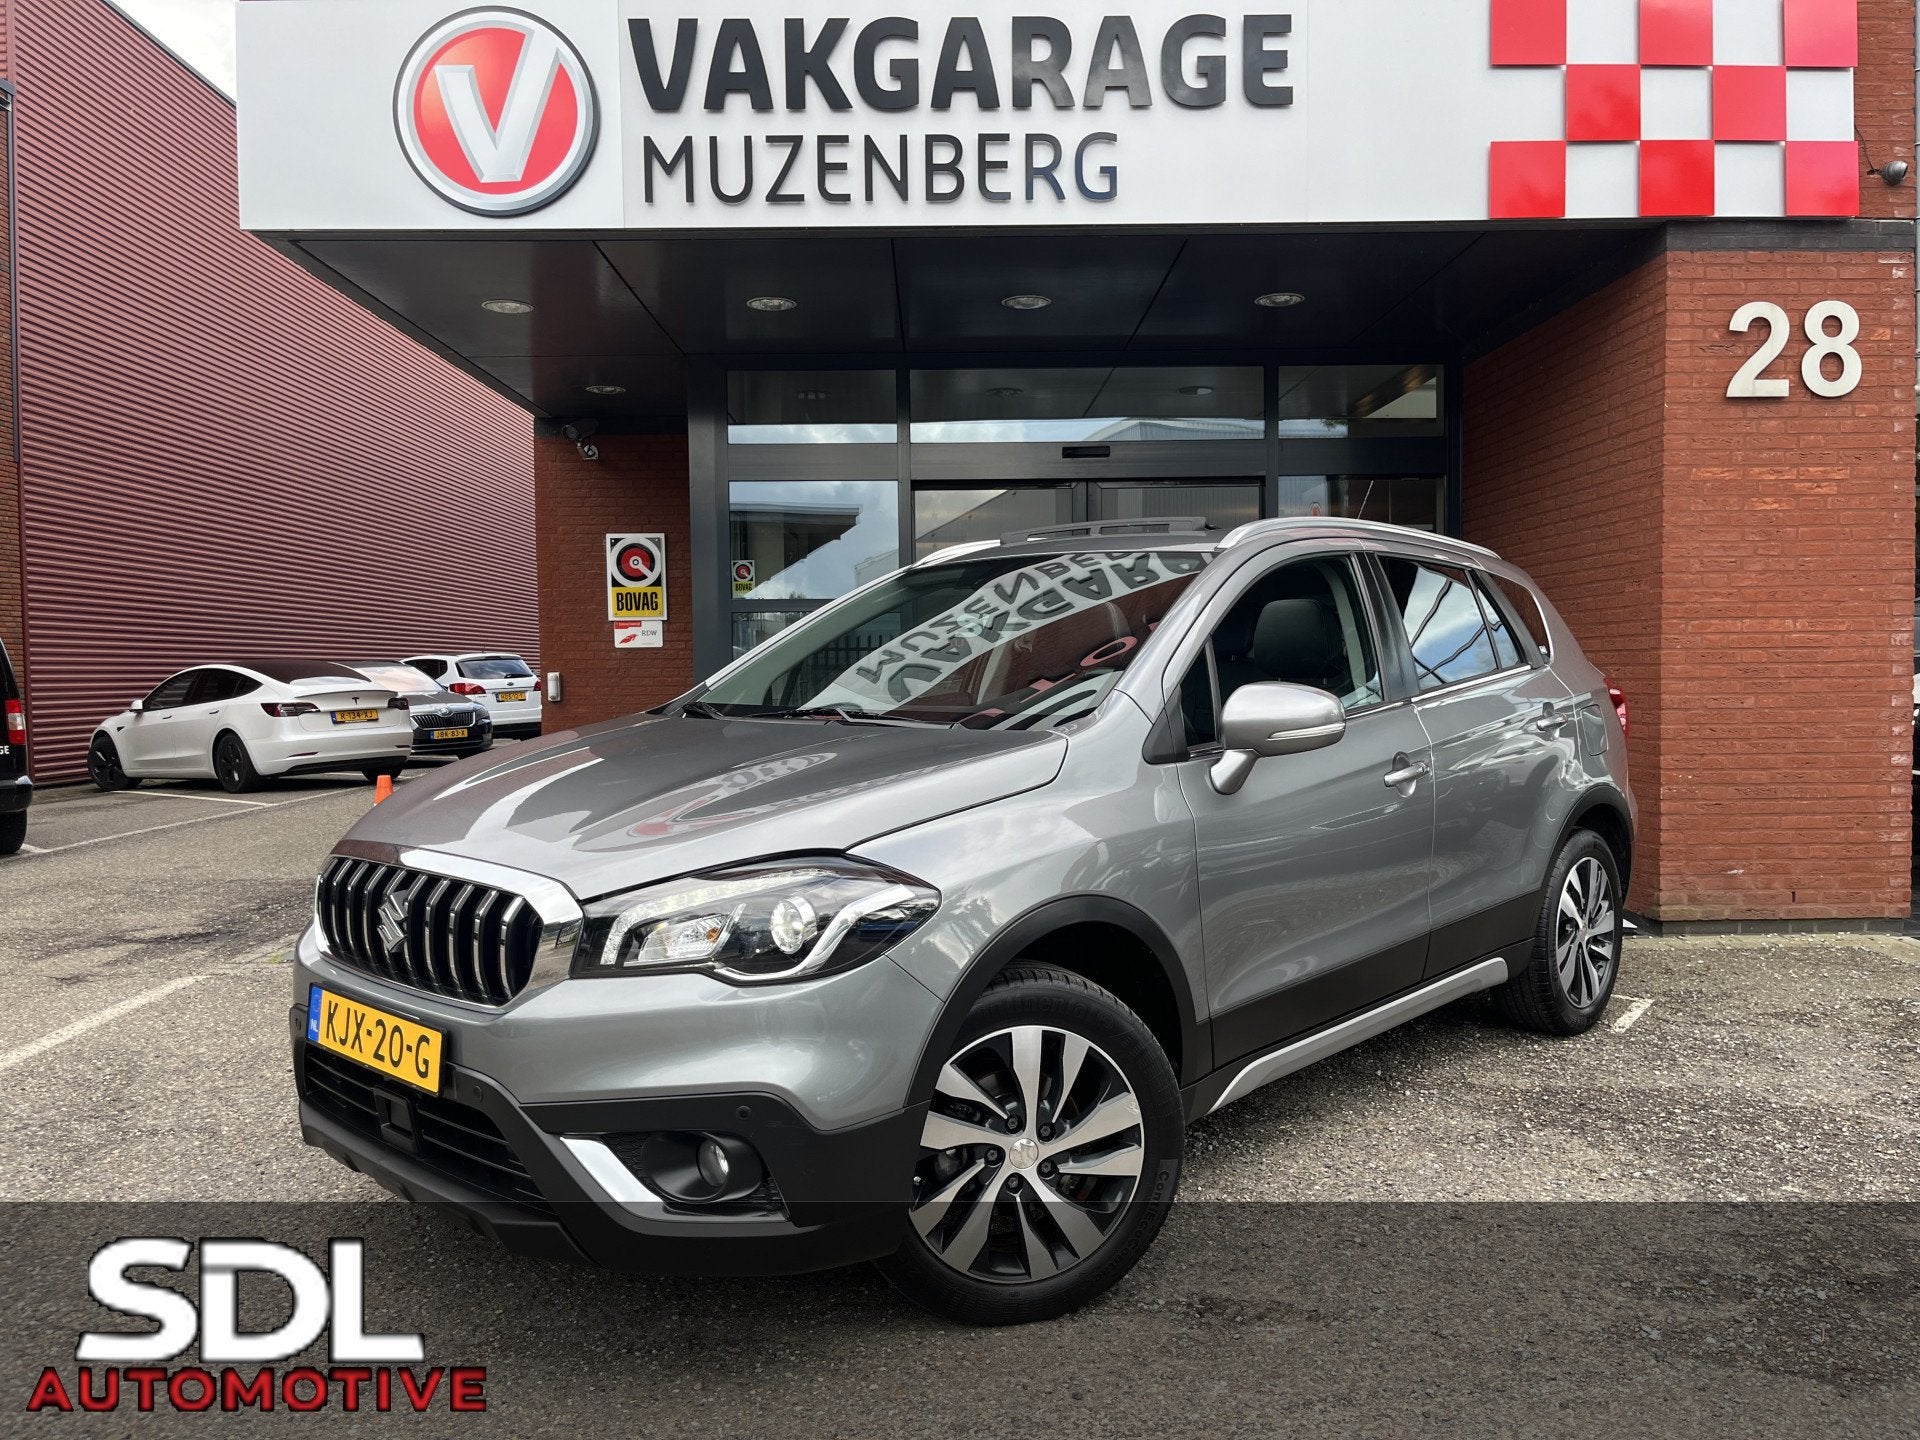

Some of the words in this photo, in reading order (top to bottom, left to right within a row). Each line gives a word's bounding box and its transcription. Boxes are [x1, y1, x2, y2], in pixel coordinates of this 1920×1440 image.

[627, 14, 1294, 112] VAKGARAGE
[643, 131, 1119, 204] MUZENBERG
[1726, 300, 1863, 398] 28
[616, 592, 659, 612] BOVAG
[735, 582, 753, 592] BOVAG
[326, 1000, 431, 1079] KJX-20-G
